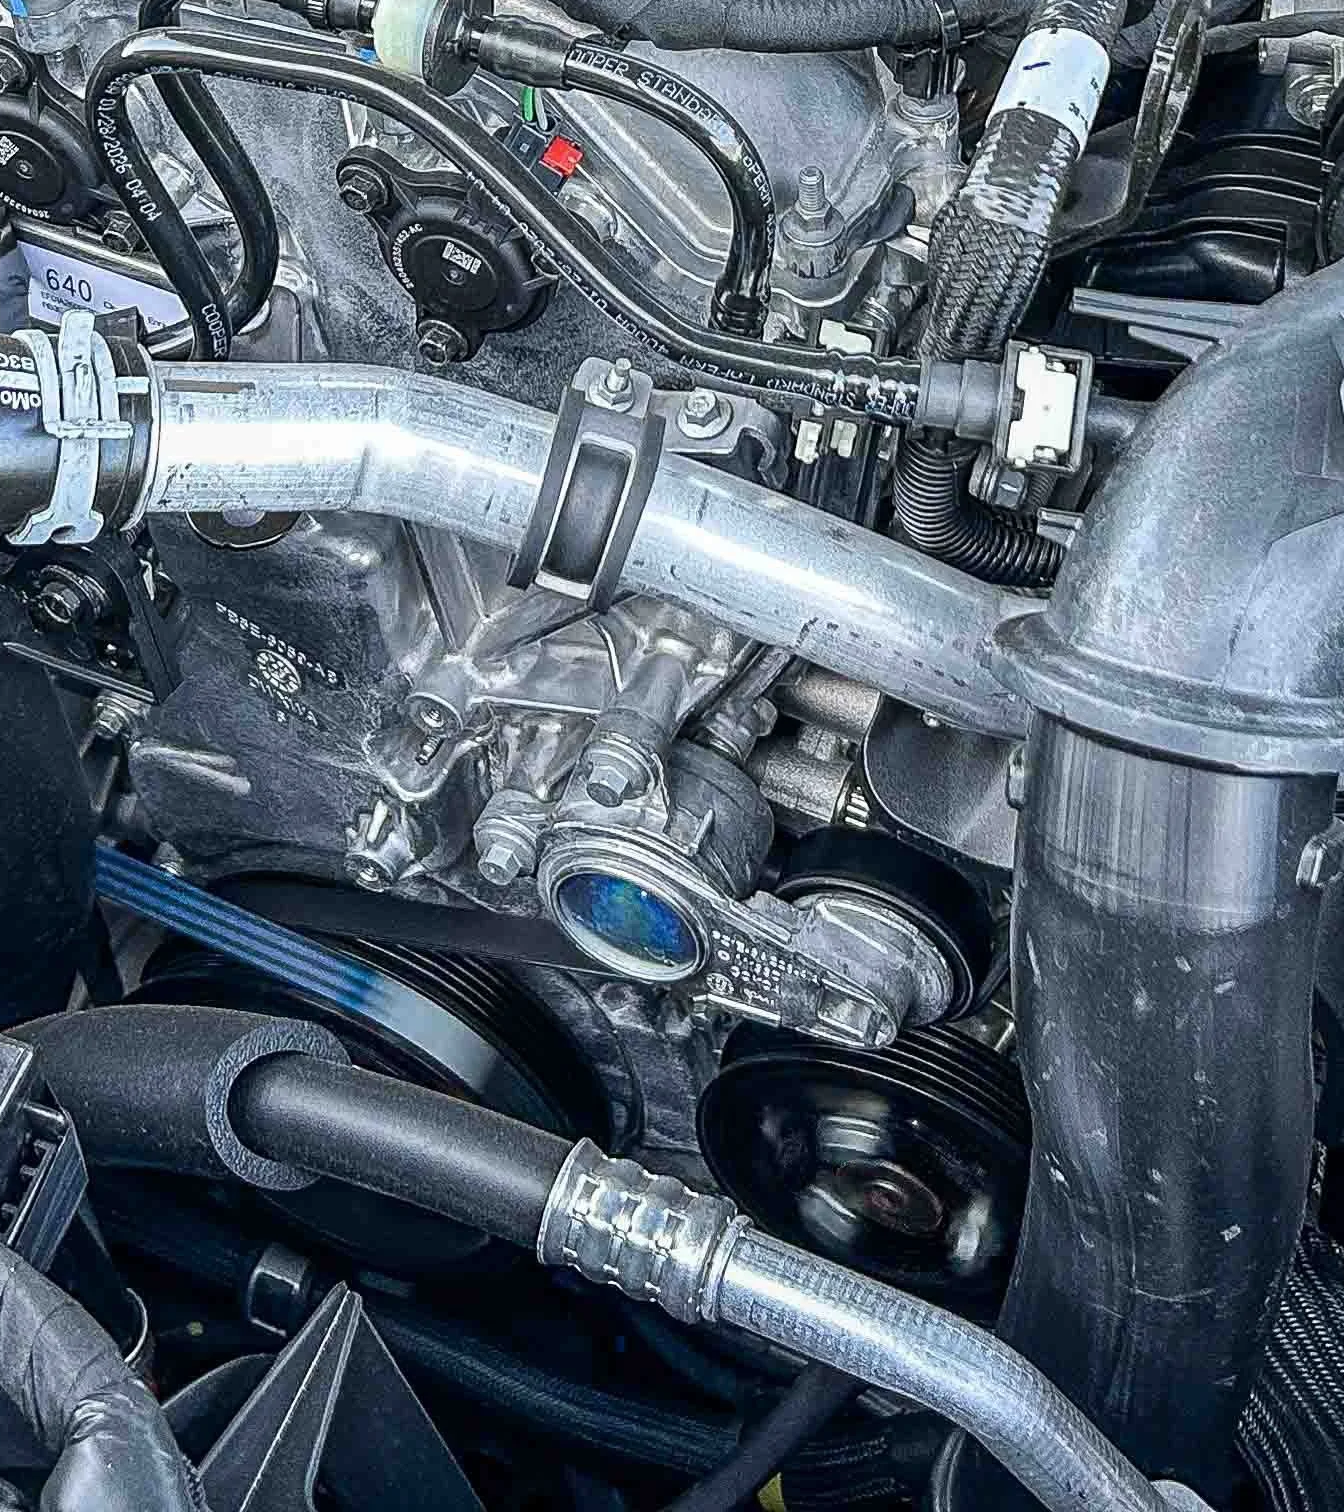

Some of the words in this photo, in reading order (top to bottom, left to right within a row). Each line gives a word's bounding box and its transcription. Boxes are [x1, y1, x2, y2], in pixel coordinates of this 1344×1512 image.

[569, 49, 630, 78] OOPER
[45, 267, 93, 304] 640
[201, 302, 229, 359] COOPER
